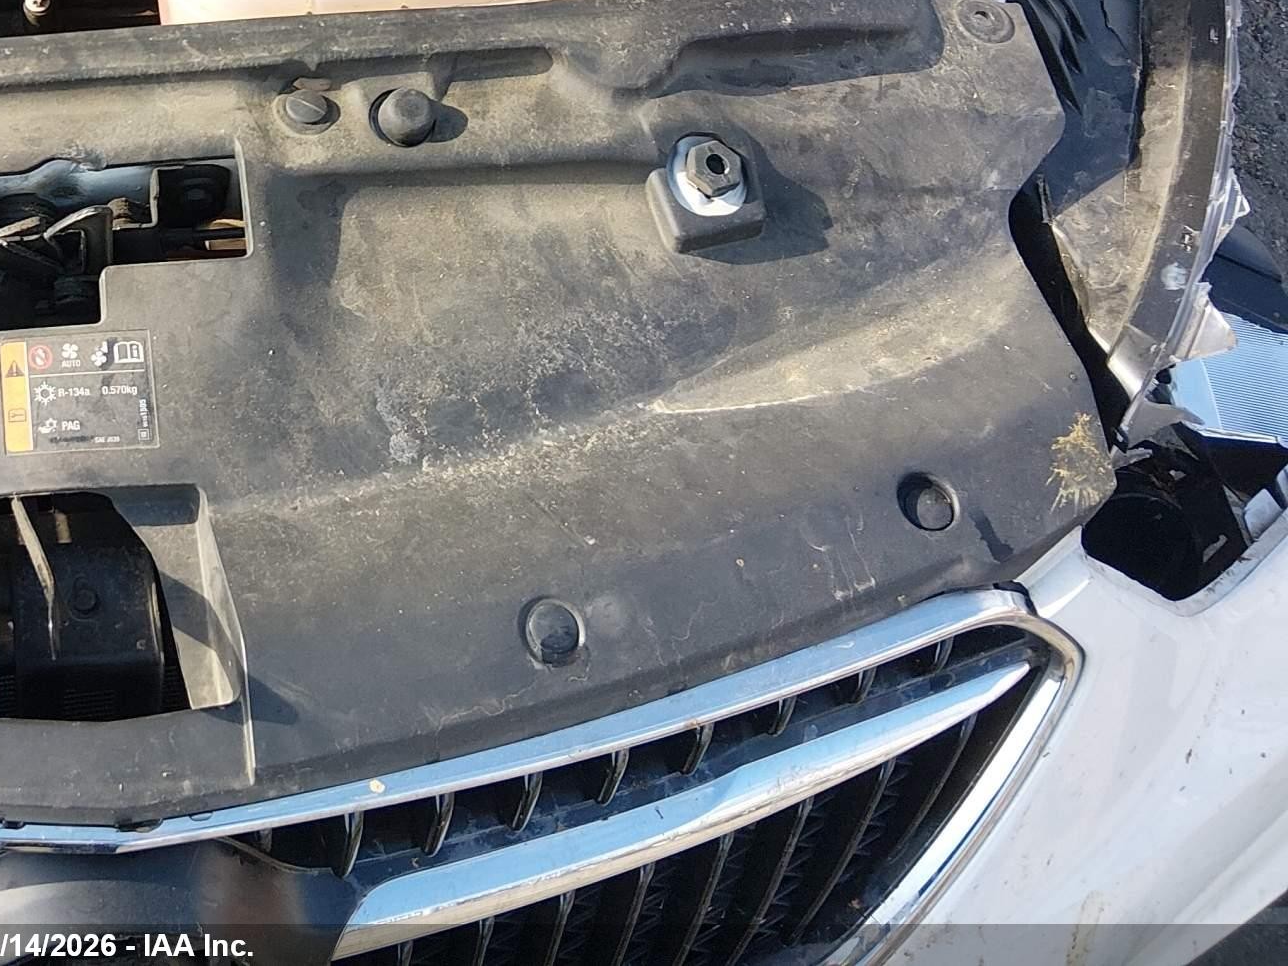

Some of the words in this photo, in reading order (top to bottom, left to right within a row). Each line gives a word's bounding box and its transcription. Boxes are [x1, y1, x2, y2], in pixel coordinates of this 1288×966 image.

[61, 359, 81, 368] AUTO
[57, 386, 91, 398] R-134a
[101, 384, 138, 397] 0.570kg
[61, 420, 81, 432] PAG
